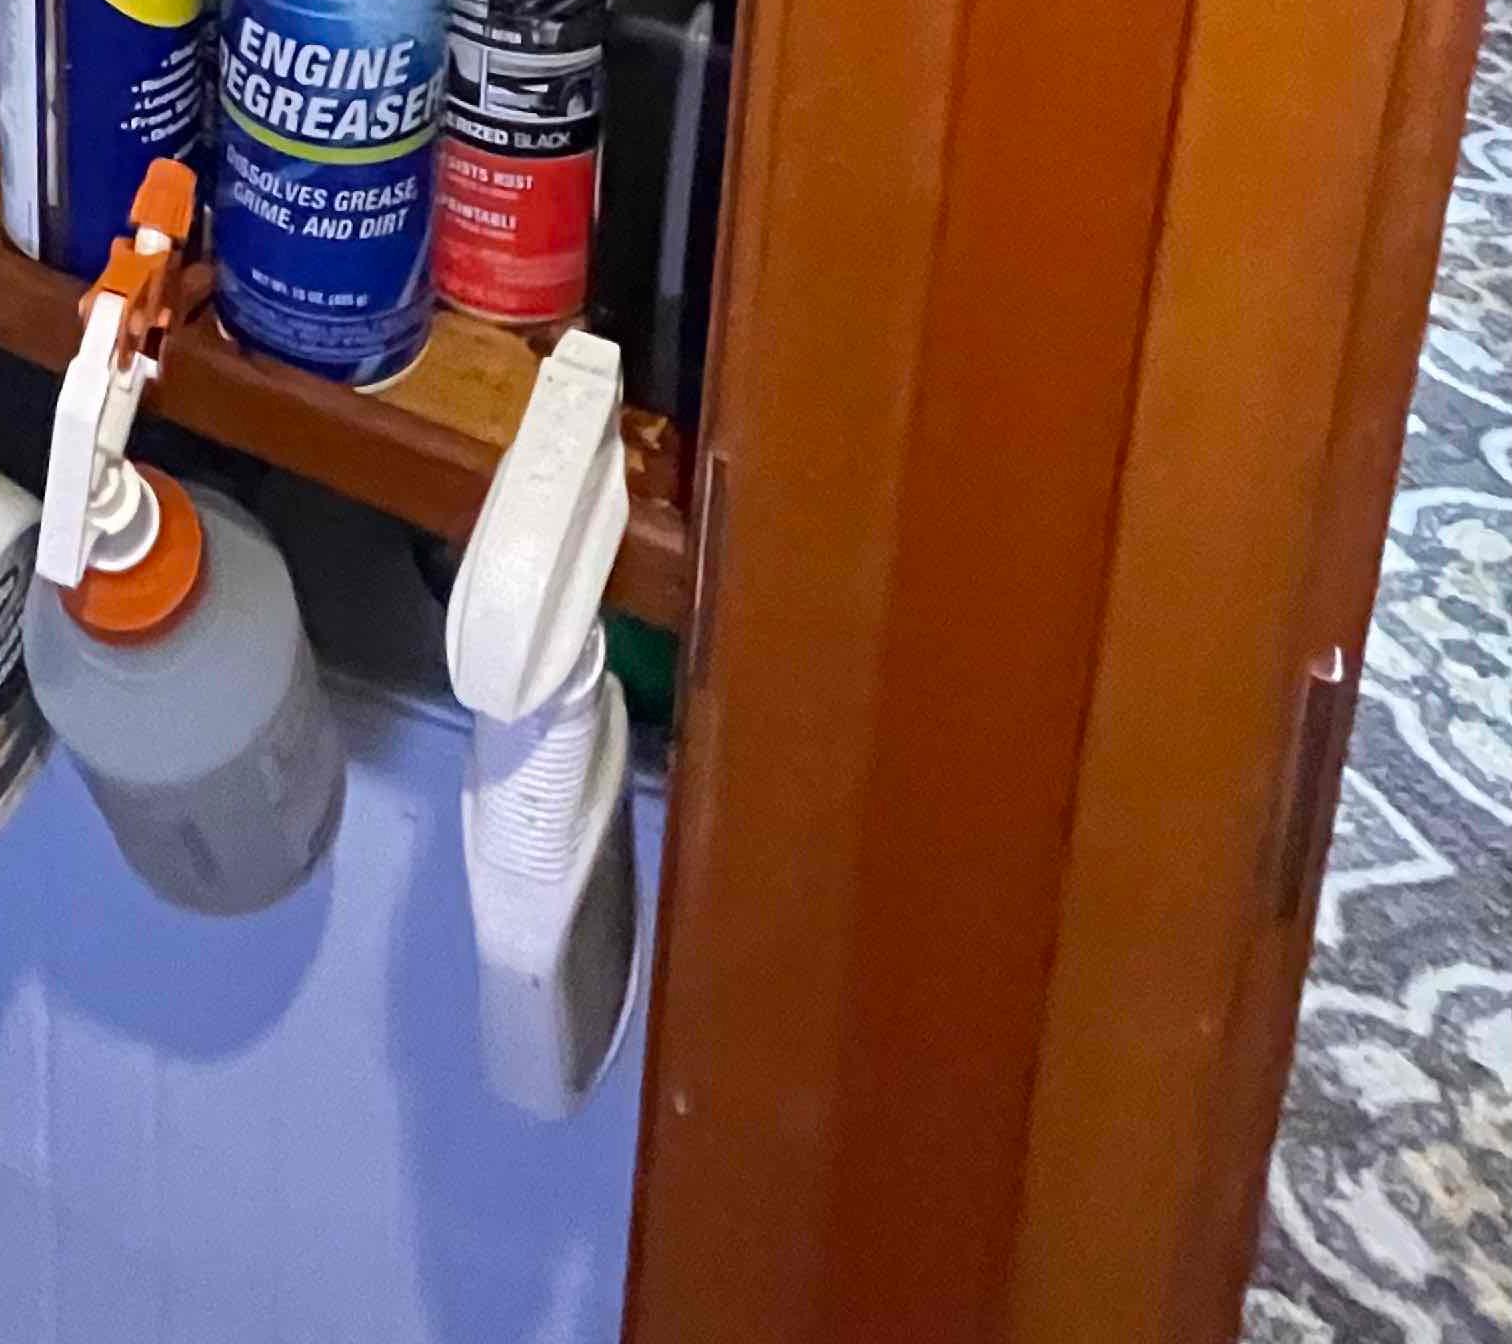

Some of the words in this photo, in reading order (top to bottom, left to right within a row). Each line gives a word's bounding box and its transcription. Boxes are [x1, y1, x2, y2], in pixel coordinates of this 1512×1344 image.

[239, 16, 415, 90] ENGINE
[514, 130, 572, 150] BLACK
[232, 181, 296, 236] GRIME,
[302, 214, 354, 241] AND
[358, 207, 409, 241] DIRT
